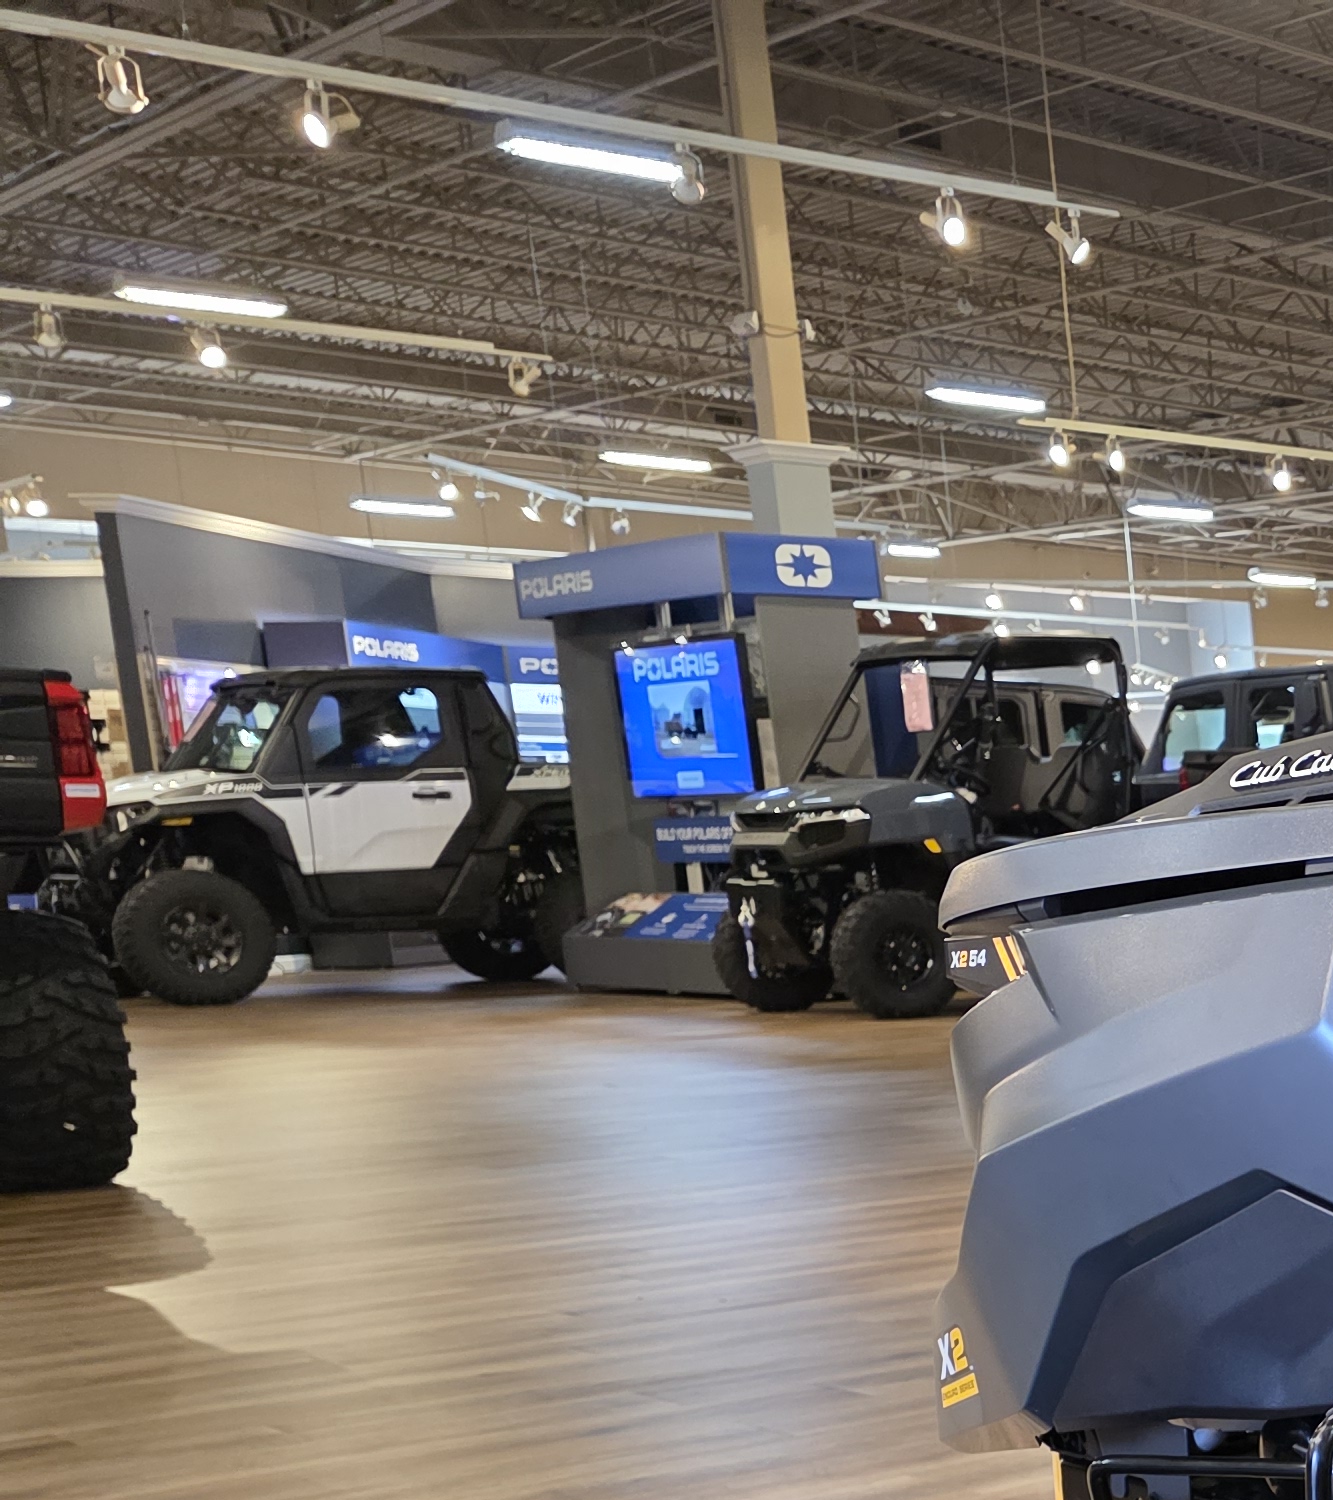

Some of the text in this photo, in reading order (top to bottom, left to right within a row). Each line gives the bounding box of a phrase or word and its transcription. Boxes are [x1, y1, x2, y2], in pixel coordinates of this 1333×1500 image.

[521, 570, 593, 600] POLARIS
[352, 635, 419, 663] POLARIS
[632, 652, 720, 682] POLARIS
[1230, 756, 1289, 788] Cub
[203, 782, 234, 796] XP
[938, 1327, 969, 1381] X2
